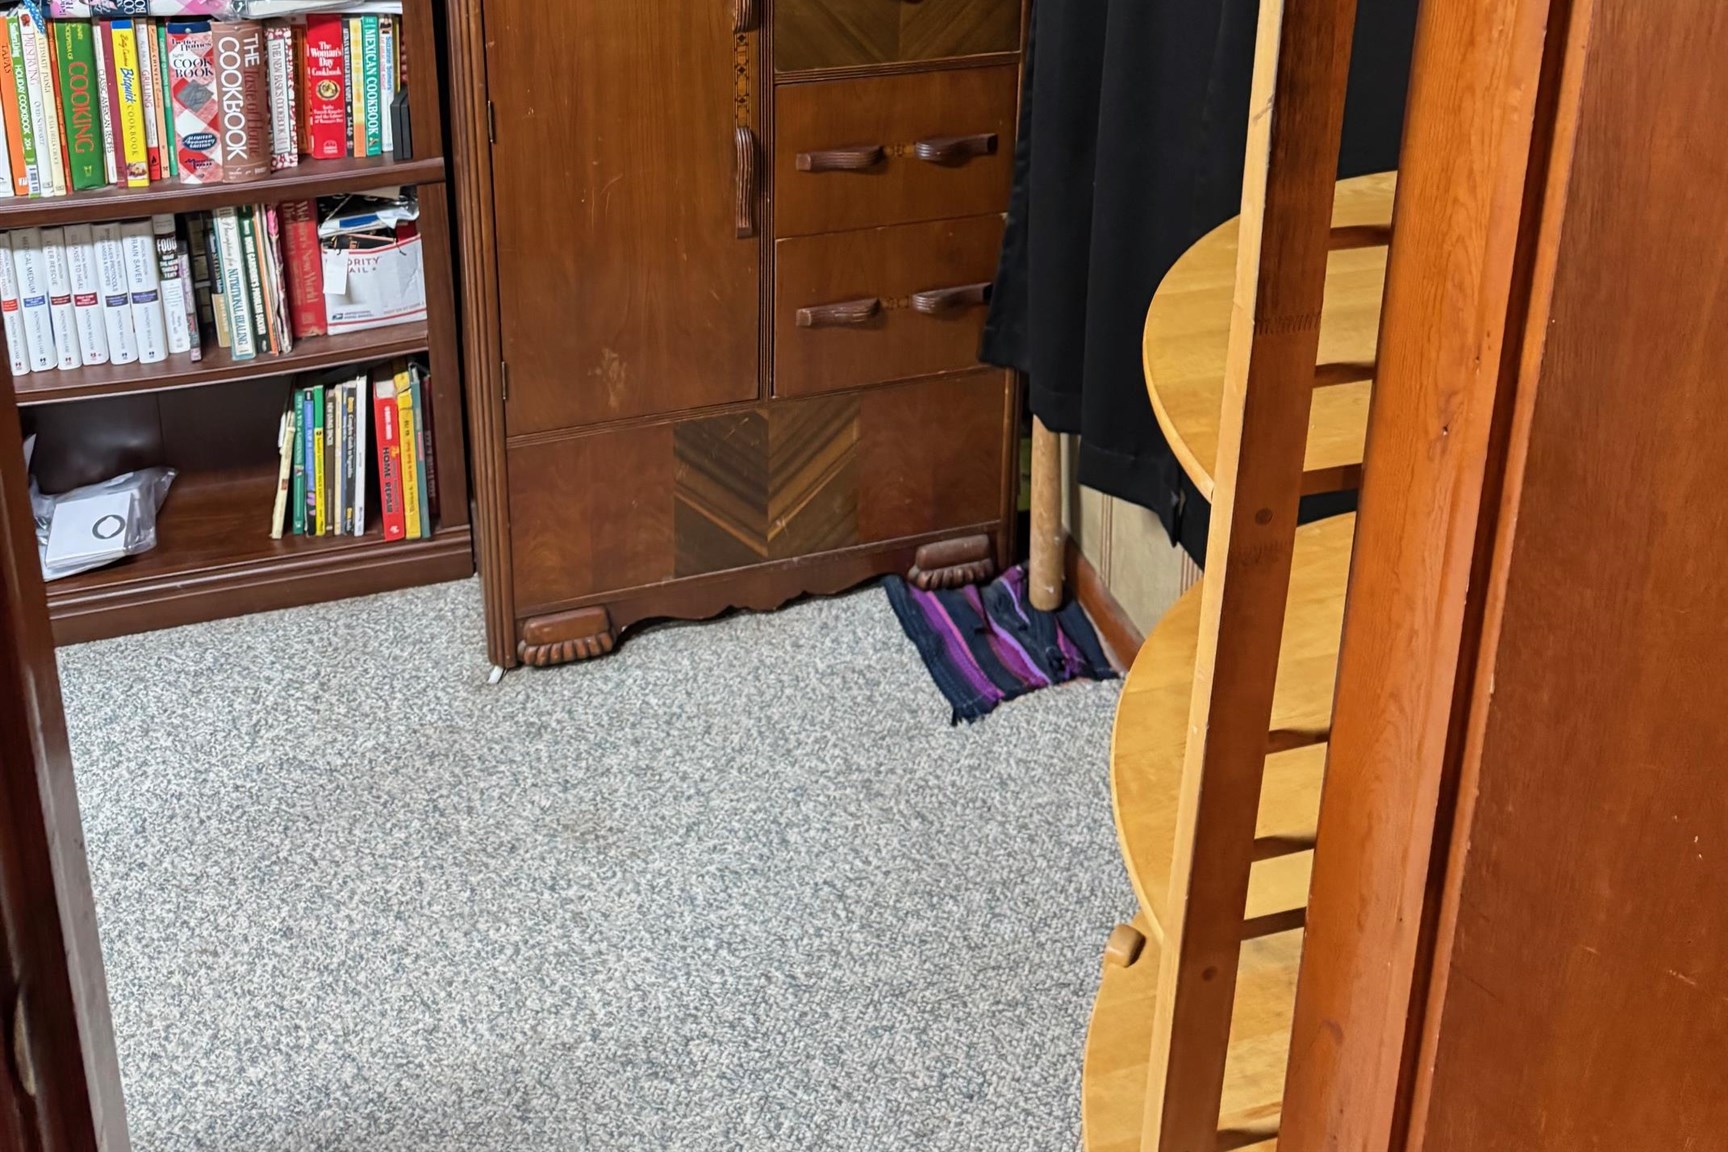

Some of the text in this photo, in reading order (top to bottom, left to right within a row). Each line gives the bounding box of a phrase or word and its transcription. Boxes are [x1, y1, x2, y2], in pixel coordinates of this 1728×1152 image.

[1, 43, 12, 74] TAPAS
[22, 32, 39, 86] PRESERVING
[243, 33, 260, 68] THE
[310, 47, 342, 58] Woman's
[318, 40, 332, 49] The
[152, 54, 160, 86] CHINESE
[173, 58, 213, 69] COOK
[175, 67, 214, 78] BOOK
[272, 58, 283, 74] NEW
[311, 67, 342, 76] Cookbook
[318, 57, 334, 69] Day
[14, 65, 26, 93] HOLIDAY
[120, 67, 136, 104] Bisquick
[141, 70, 154, 108] GRILLING
[273, 74, 285, 97] BASICS
[364, 28, 379, 136] MEXICAN COOKBOOK
[68, 61, 95, 154] COOKING
[98, 69, 114, 154] CLASSIC AMERICAN RECIPES
[218, 36, 248, 161] COOKBOOK
[18, 94, 31, 135] COOKBOOK
[127, 105, 138, 157] COOKBOOK
[22, 236, 33, 267] MEDICAL
[302, 249, 313, 271] New
[26, 267, 36, 294] MEDIUM
[49, 260, 58, 287] RESCUE
[134, 259, 143, 284] SAVER
[304, 272, 319, 303] World
[227, 268, 243, 314] NUTRITIONAL
[235, 314, 249, 346] HEALING
[382, 447, 391, 478] HOME
[384, 482, 393, 514] REPAIR
